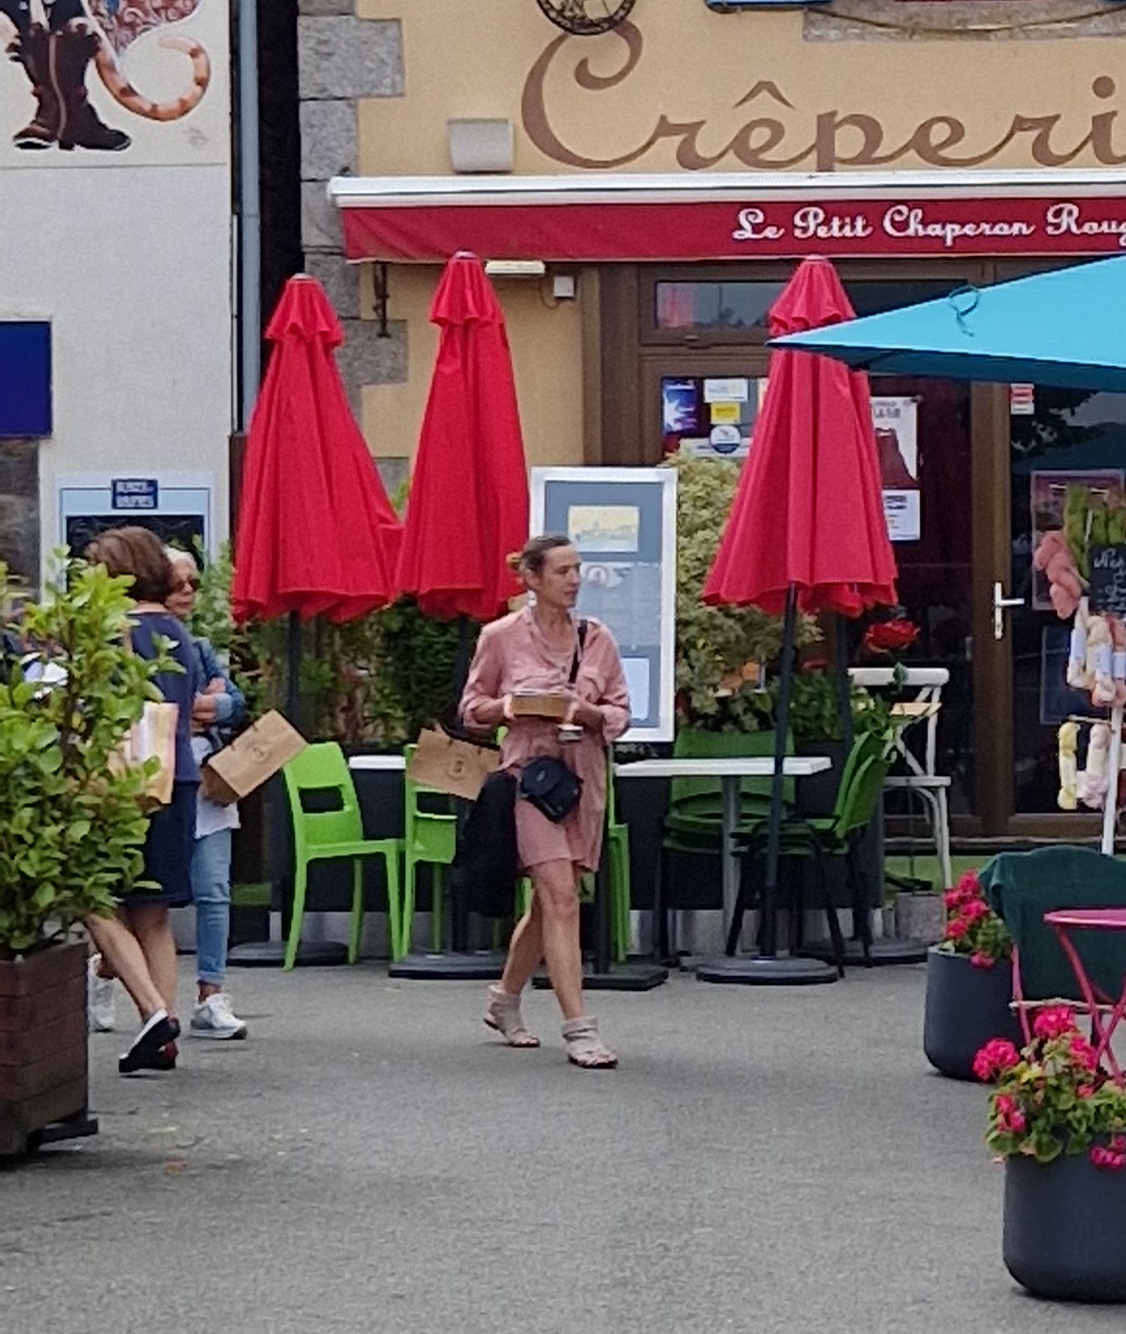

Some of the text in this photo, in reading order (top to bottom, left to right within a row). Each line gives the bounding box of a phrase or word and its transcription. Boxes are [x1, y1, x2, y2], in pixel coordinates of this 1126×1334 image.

[731, 208, 786, 241] Le
[793, 205, 872, 240] Petit
[882, 204, 1037, 248] Chaperon
